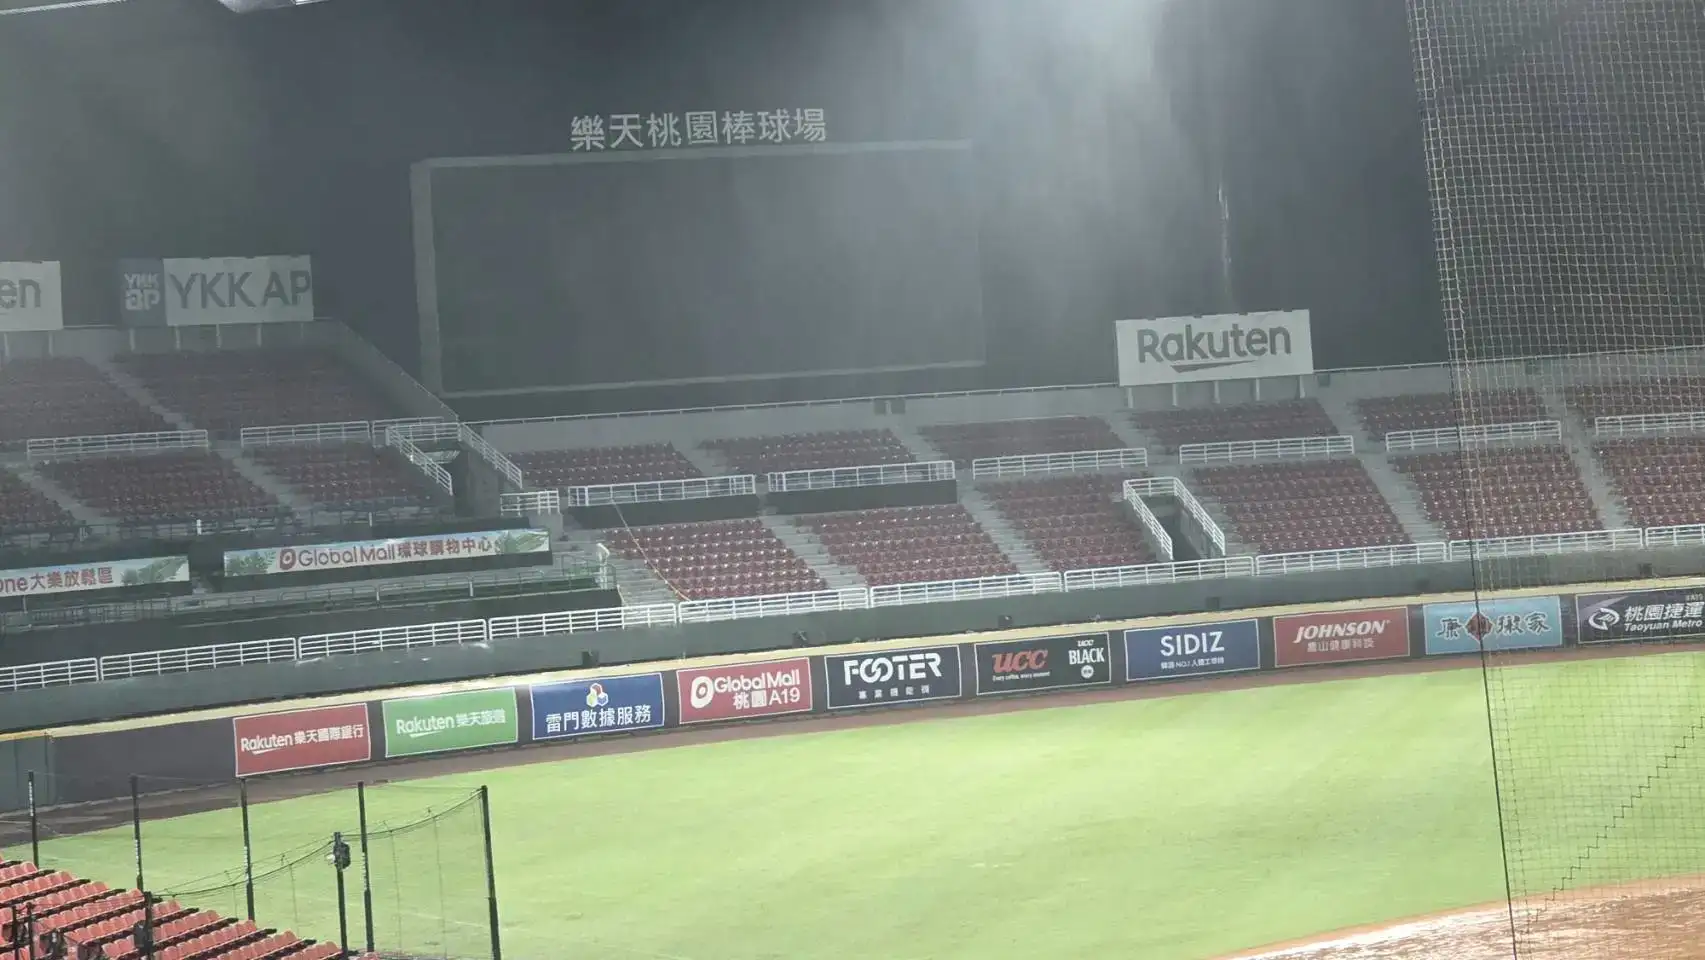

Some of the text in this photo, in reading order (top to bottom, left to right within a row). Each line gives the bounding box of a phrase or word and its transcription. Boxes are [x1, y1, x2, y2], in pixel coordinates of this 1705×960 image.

[570, 107, 827, 151] 樂天桃園棒球場
[124, 273, 159, 289] YKK
[169, 270, 311, 309] YKK AP
[1137, 323, 1292, 363] Rakuten
[298, 545, 357, 567] Global
[360, 543, 396, 562] Mall
[1624, 601, 1705, 622] 桃園捷運
[1292, 619, 1386, 643] JOHNSON
[1624, 619, 1703, 633] Taoyuan Metro
[1160, 631, 1225, 656] SIDIZ
[1068, 647, 1105, 665] BLACK
[843, 652, 943, 685] FOOTER
[714, 669, 801, 693] Global Mall
[396, 715, 455, 735] Rakuten
[545, 704, 651, 733] 雷門數據服務
[241, 733, 293, 752] Rakuten
